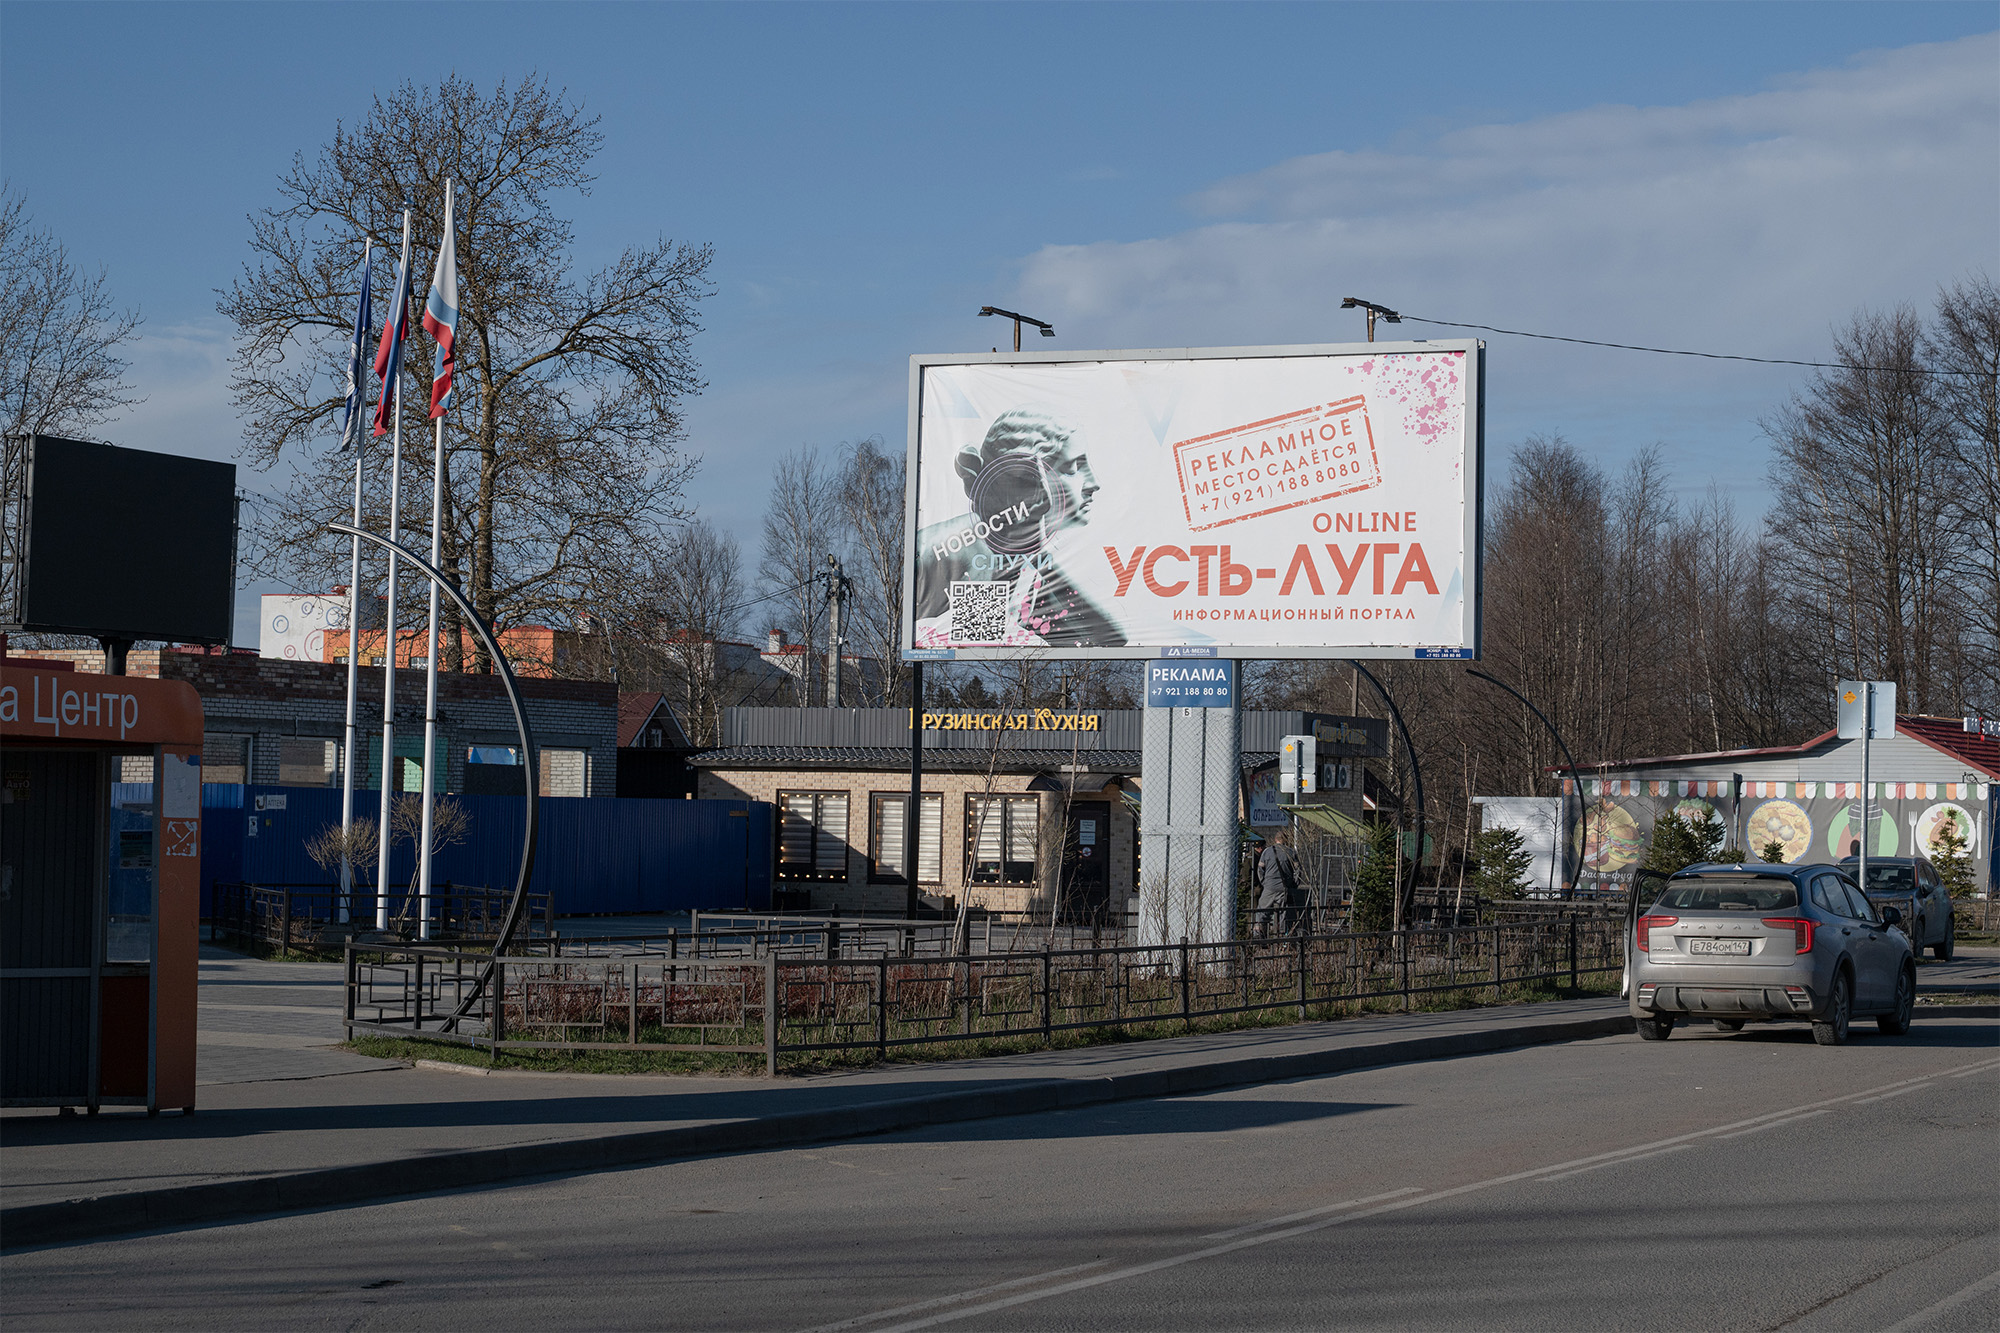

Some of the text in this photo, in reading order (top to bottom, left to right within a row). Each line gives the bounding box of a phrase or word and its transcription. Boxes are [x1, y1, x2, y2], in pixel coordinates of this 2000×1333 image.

[1191, 419, 1353, 476] РЕКЛАМНОЕ
[1195, 442, 1358, 496] МЕСТО СДАЁТСЯ
[1315, 460, 1361, 483] 8080
[932, 501, 1030, 562] НОВОСТИ
[1312, 511, 1417, 533] ONLINE
[971, 553, 1053, 571] СЛУХИ
[1103, 542, 1441, 598] УСТЬ-ЛУГА
[1173, 606, 1416, 622] ИНФОРМАЦИОННЫЙ ПОРТАЛ
[1152, 668, 1227, 681] РЕКЛАМА
[1151, 687, 1228, 696] +7 921 188 80 80
[33, 675, 139, 740] Центр
[1732, 942, 1747, 950] 147
